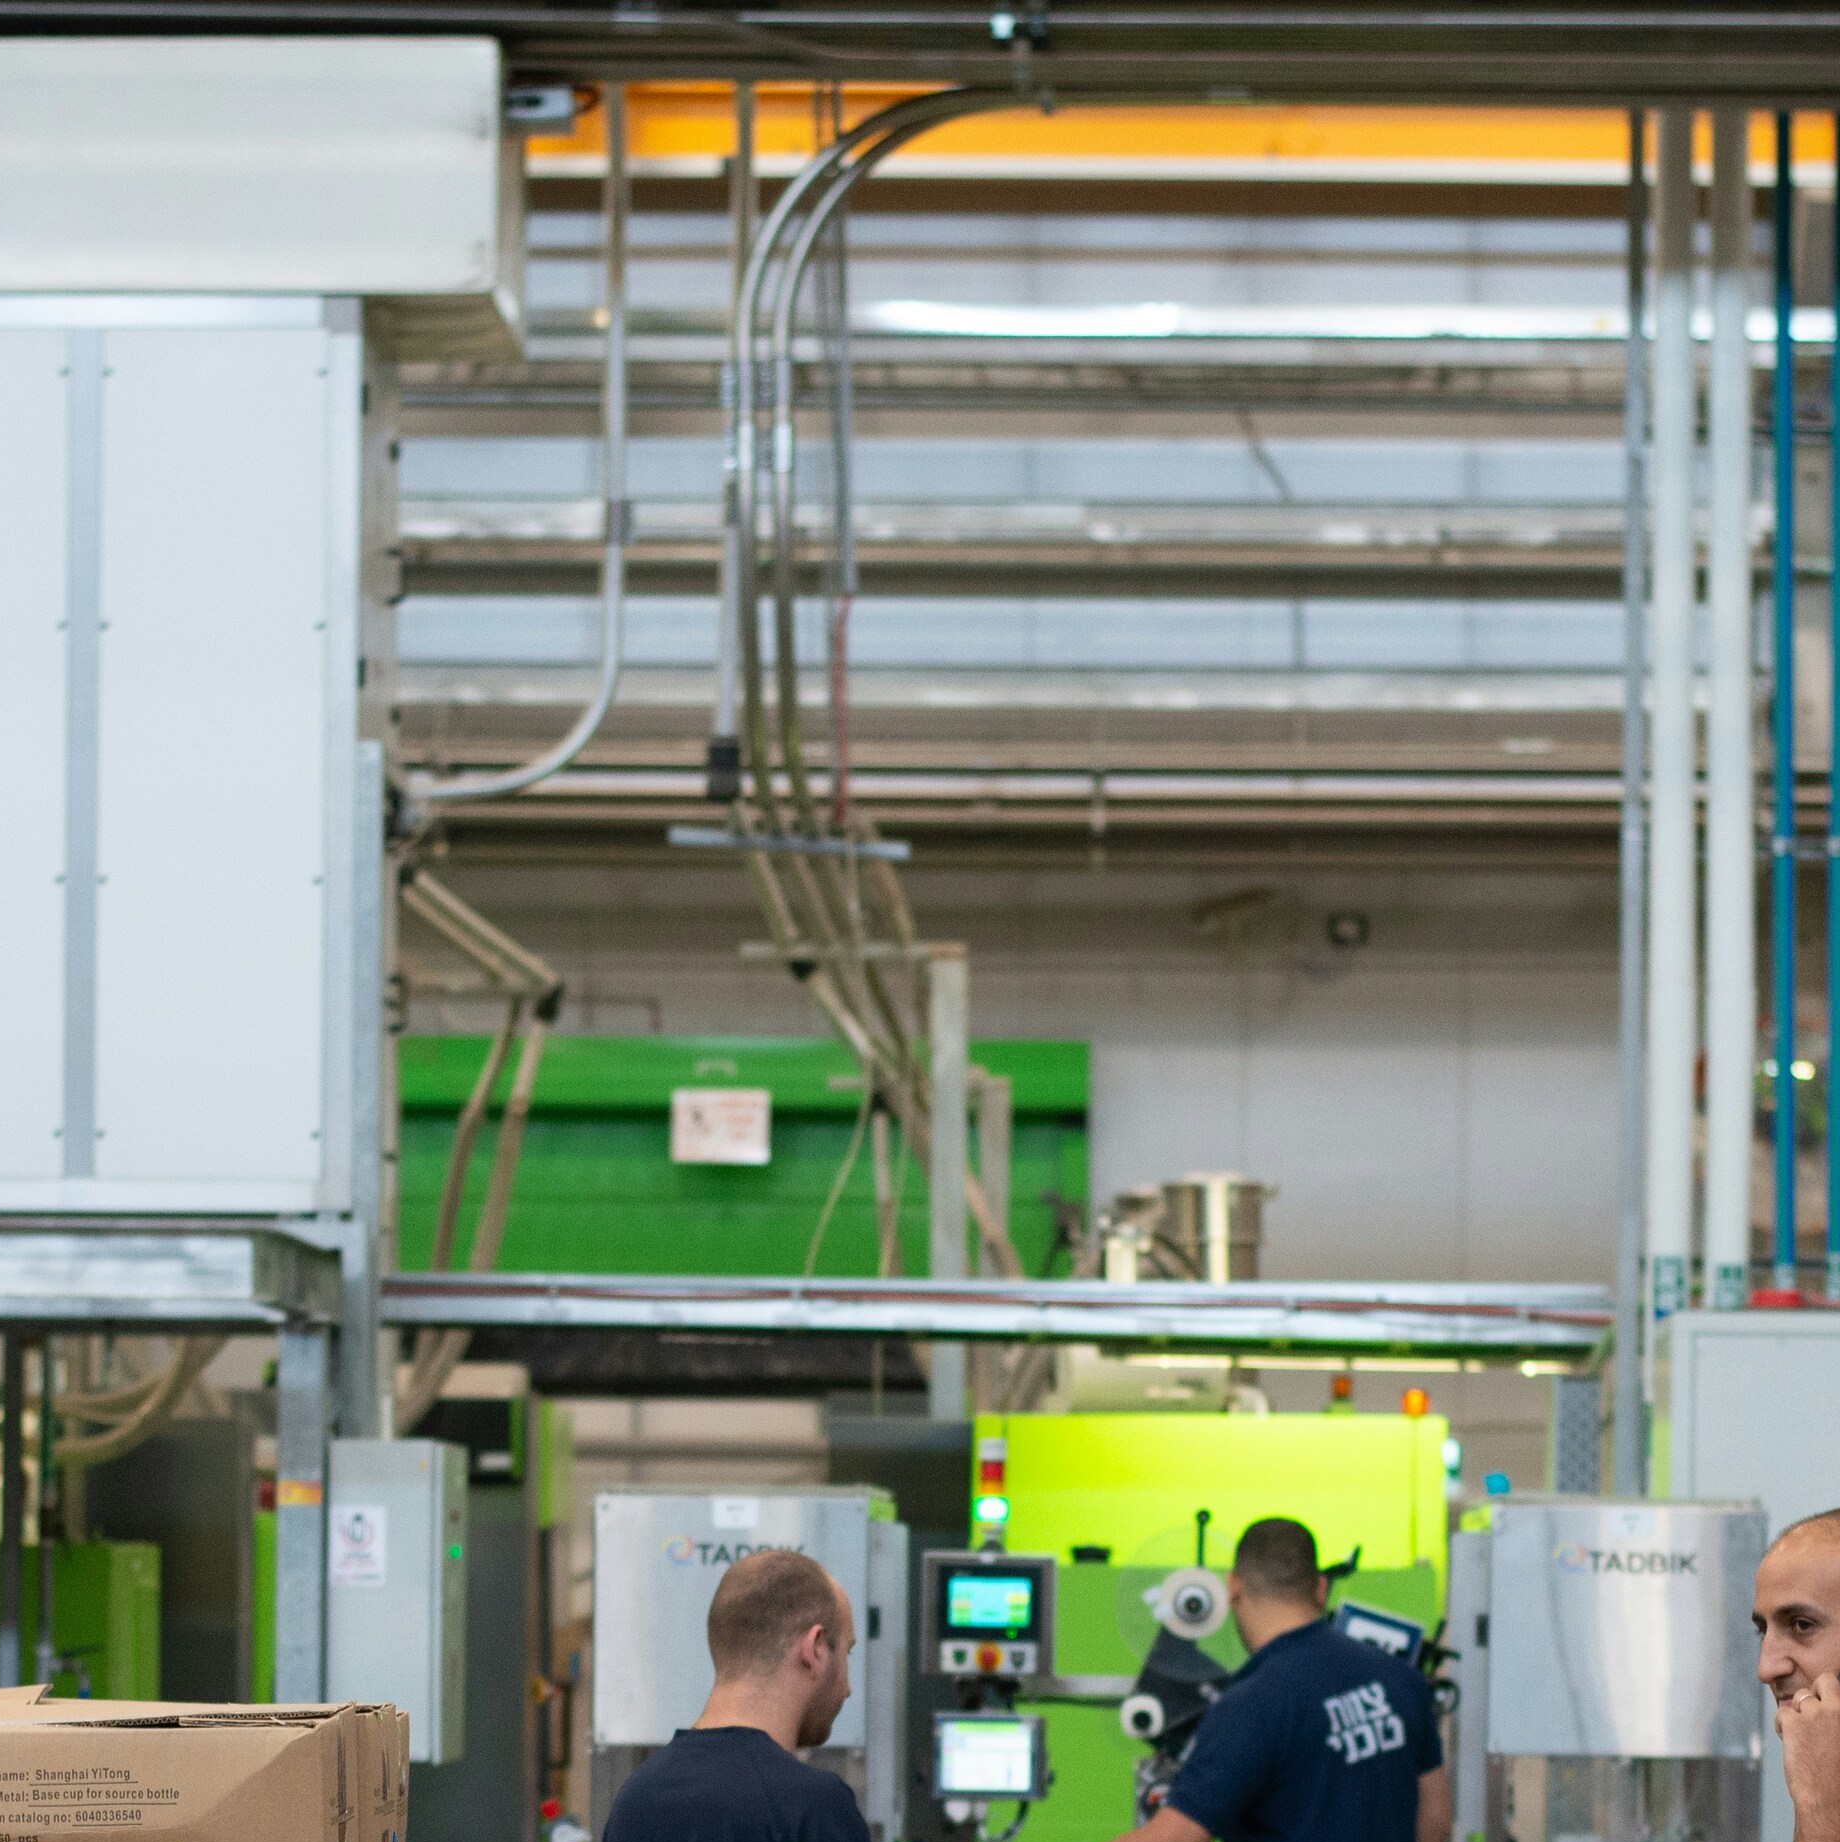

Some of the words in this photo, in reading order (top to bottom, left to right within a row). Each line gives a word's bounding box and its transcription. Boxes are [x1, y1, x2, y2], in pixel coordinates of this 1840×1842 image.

[1590, 1551, 1696, 1575] TADBIK
[34, 1768, 89, 1783] Shanghai
[91, 1767, 132, 1780] YiTong
[32, 1789, 60, 1801] Base
[62, 1790, 84, 1802] cup
[85, 1787, 103, 1799] for
[104, 1789, 145, 1799] source
[146, 1788, 181, 1800] bottle
[8, 1811, 51, 1826] catalog
[53, 1813, 72, 1823] no:
[75, 1809, 142, 1822] 6040336540
